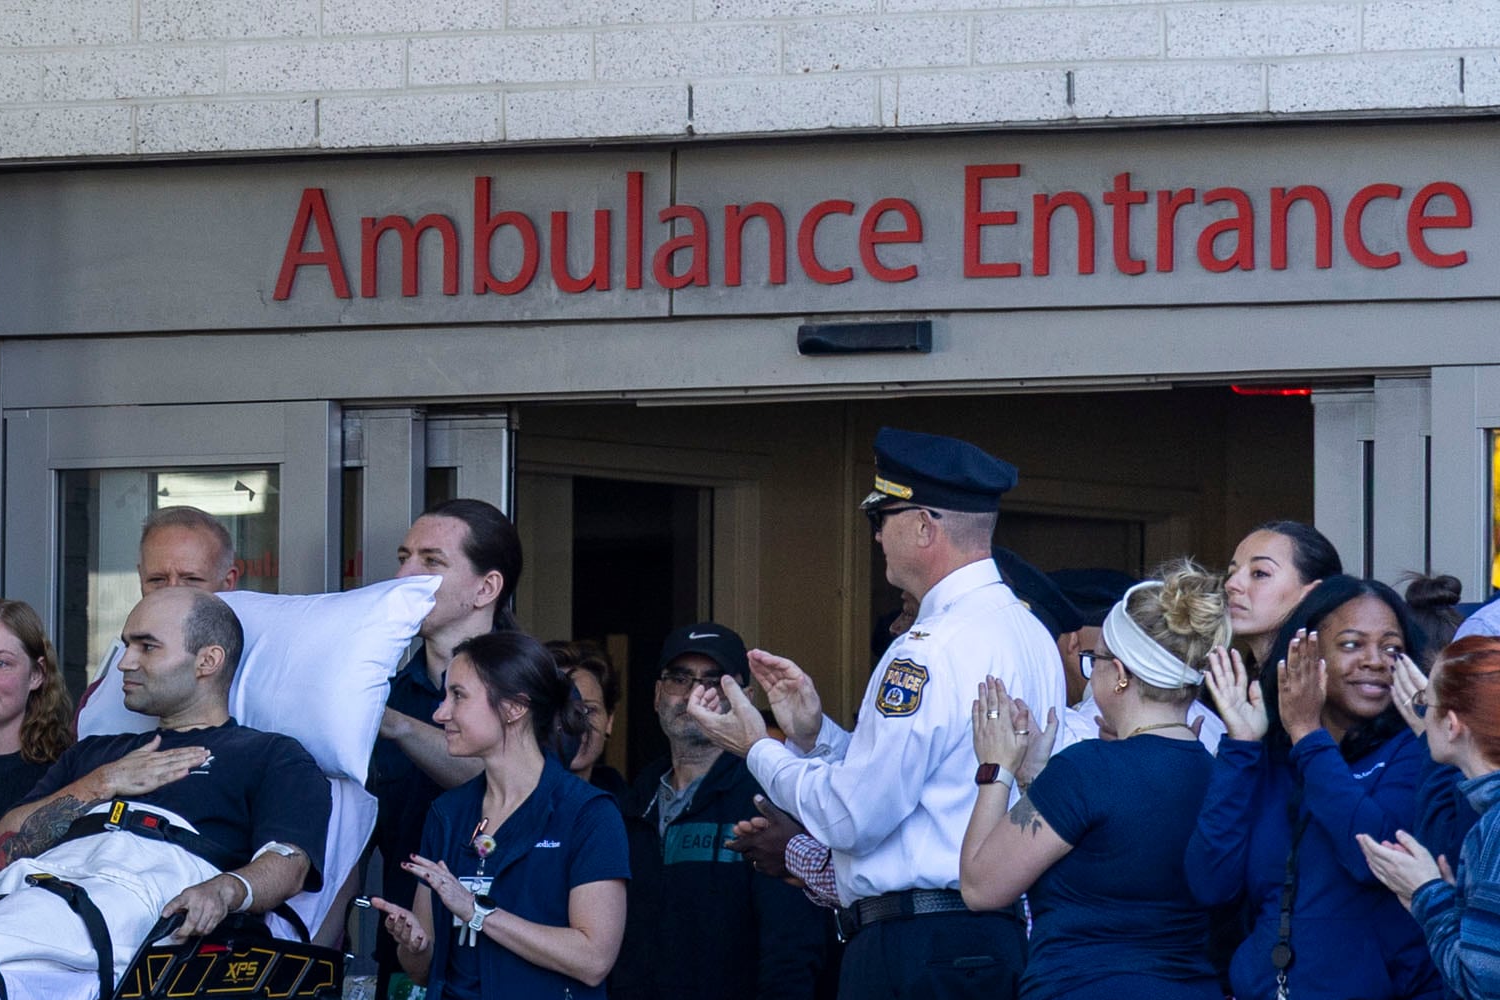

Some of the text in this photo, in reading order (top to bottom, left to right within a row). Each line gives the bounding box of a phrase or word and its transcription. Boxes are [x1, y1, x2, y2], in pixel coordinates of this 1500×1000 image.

[274, 163, 1472, 299] Ambulance Entrance
[885, 669, 922, 692] POLICE
[681, 833, 740, 849] EAGE
[226, 961, 259, 979] XPS
